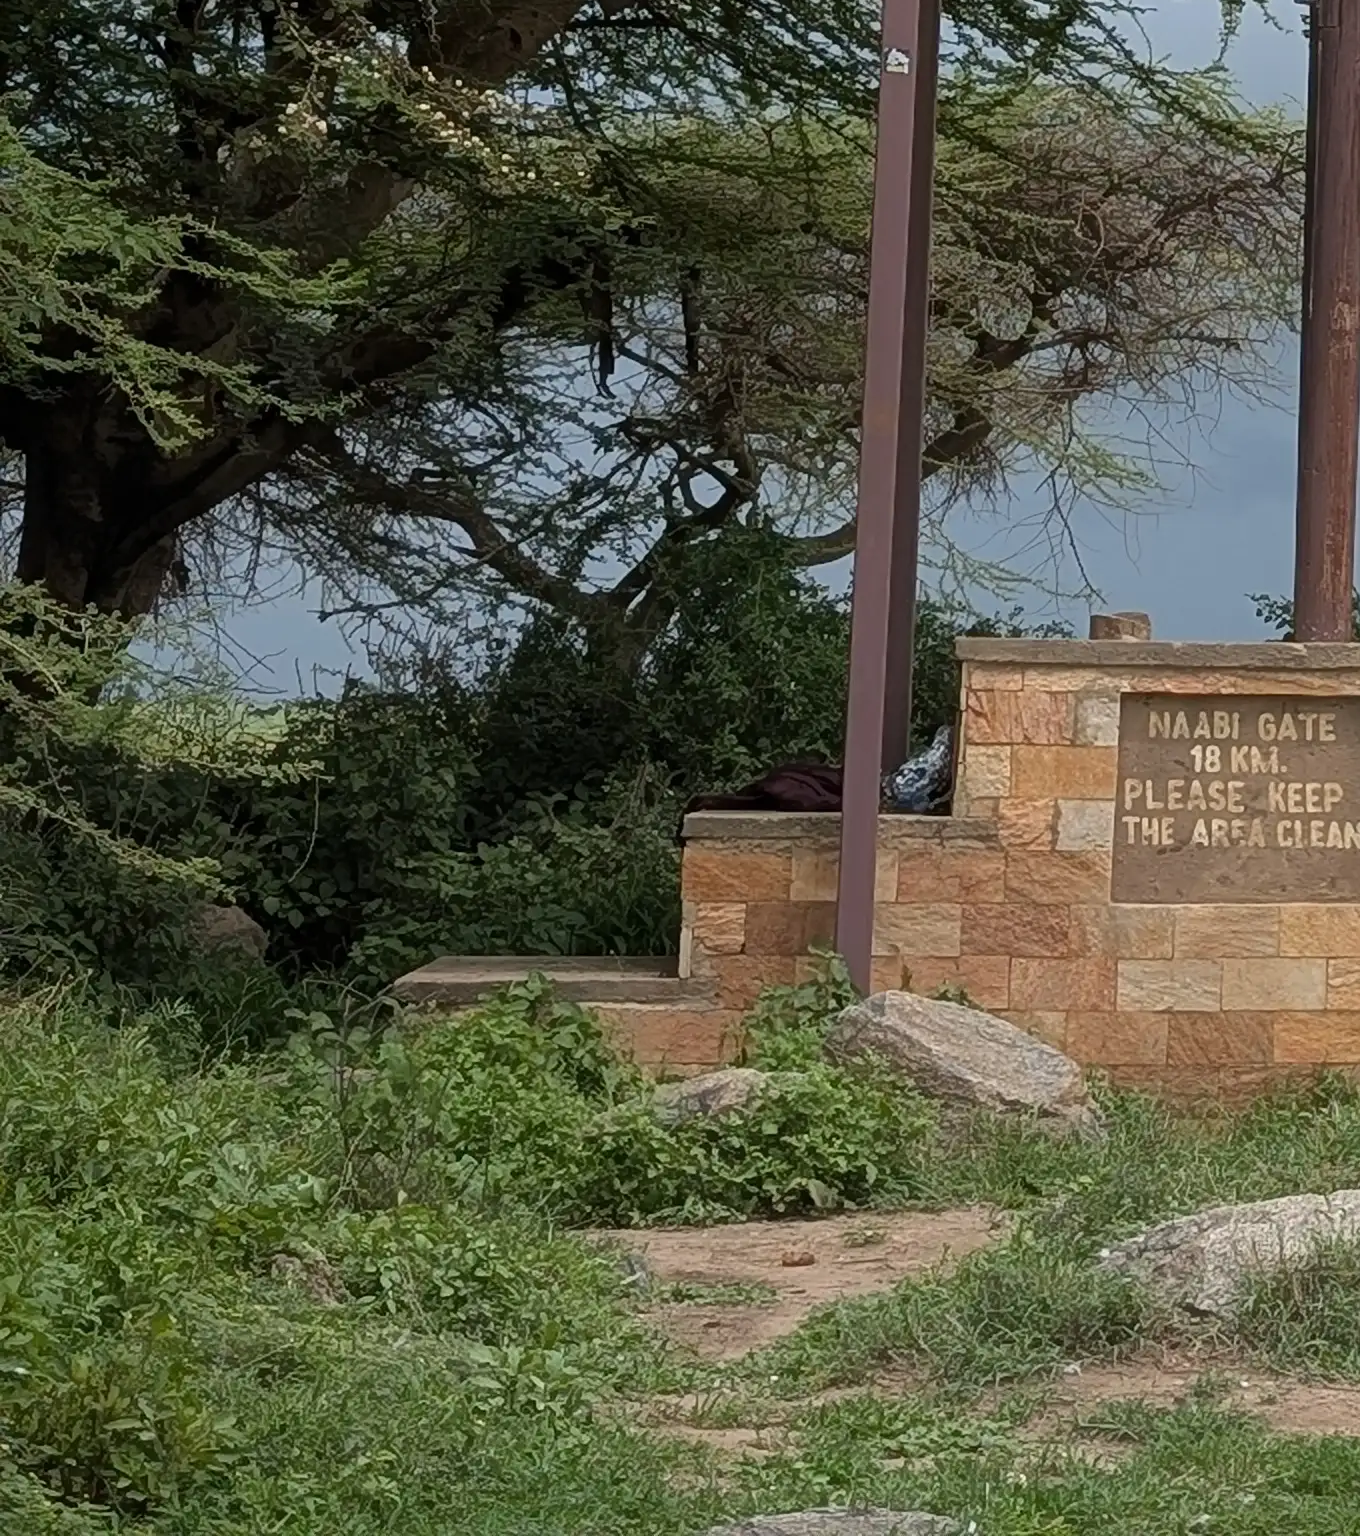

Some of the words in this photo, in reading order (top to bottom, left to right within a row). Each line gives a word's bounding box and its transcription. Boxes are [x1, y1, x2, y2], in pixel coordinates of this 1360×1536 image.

[1148, 711, 1240, 740] NAABI
[1258, 712, 1337, 742] GATE
[1190, 744, 1221, 773] 18
[1231, 745, 1288, 774] KM.
[1124, 778, 1246, 813] PLEASE
[1267, 781, 1344, 813] KEEP
[1122, 815, 1175, 846] THE
[1190, 818, 1266, 848] AREA
